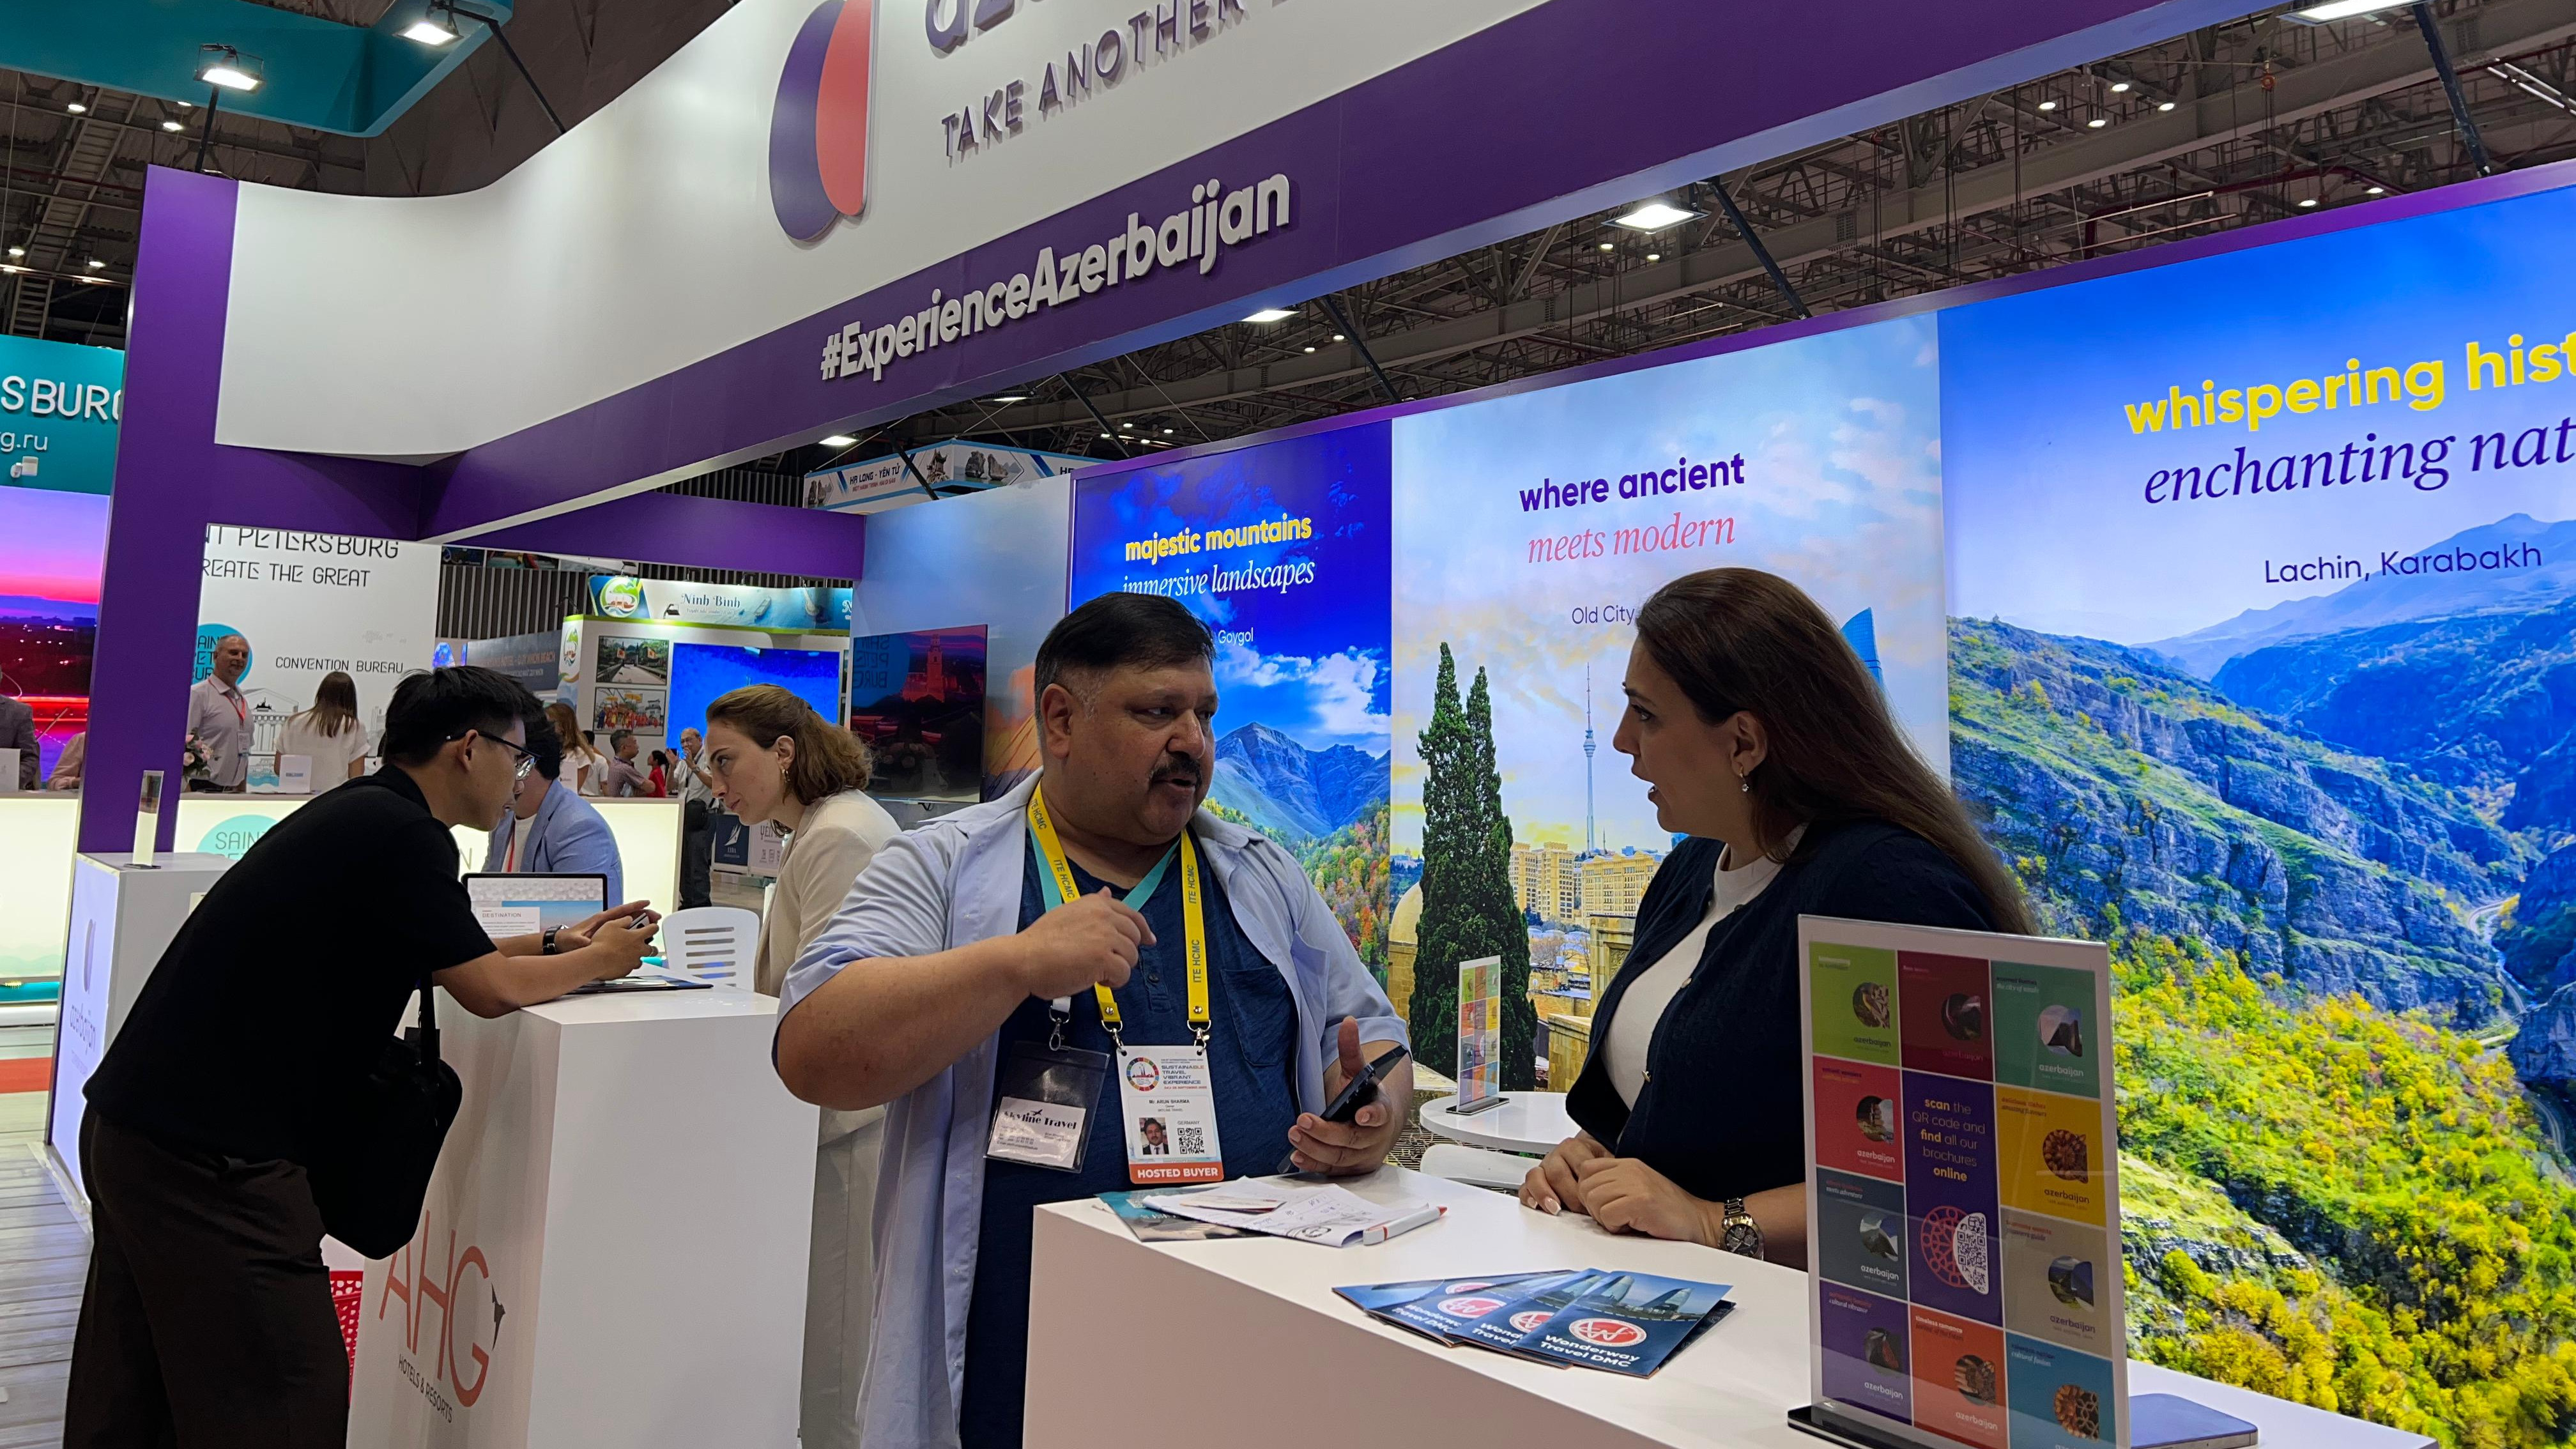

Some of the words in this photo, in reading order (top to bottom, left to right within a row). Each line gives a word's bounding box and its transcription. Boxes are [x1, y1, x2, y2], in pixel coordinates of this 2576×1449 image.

[942, 79, 1024, 158] TAKE
[820, 172, 1290, 381] #ExperienceAzerbaijan
[2124, 357, 2444, 434] whispering
[0, 432, 48, 452] g.ru
[2144, 431, 2456, 504] enchanting
[2470, 415, 2576, 471] nat
[1519, 477, 1609, 512] where
[1618, 452, 1745, 500] ancient
[1125, 528, 1200, 565] majestic
[1206, 512, 1312, 551] mountains
[1528, 528, 1606, 564] meets
[1613, 512, 1735, 555] modern
[2265, 555, 2371, 581] Lachin,
[2381, 541, 2542, 576] Karabakh
[269, 564, 303, 583] THE
[313, 567, 371, 587] GREAT
[1123, 568, 1207, 599] immersive
[1212, 560, 1315, 595] landscapes
[1572, 606, 1598, 625] Old
[1603, 605, 1635, 626] City
[1218, 627, 1254, 647] Goygol
[195, 650, 215, 665] ET
[276, 657, 349, 671] CONVENTION
[356, 661, 403, 673] BUREAU
[1033, 808, 1046, 829] HCMC
[215, 831, 268, 850] SAIN
[1054, 859, 1065, 872] ITE
[1060, 873, 1075, 898] HCMC
[1187, 864, 1195, 889] HCMC
[1188, 891, 1197, 904] ITE
[1192, 939, 1201, 966] HCMC
[1193, 969, 1202, 983] ITE
[1854, 1036, 1891, 1048] azerbaijan
[2039, 1064, 2084, 1077] azerbaijan
[1924, 1099, 1950, 1111] scan
[1954, 1102, 1971, 1115] the
[1912, 1110, 1929, 1124] QR
[1932, 1117, 1960, 1129] code
[1963, 1123, 1986, 1135] and
[1920, 1129, 1942, 1142] find
[1944, 1134, 1957, 1146] all
[1960, 1138, 1977, 1149] our
[1857, 1150, 1895, 1163] azerbaijan
[1923, 1146, 1977, 1167] brochures
[1137, 1169, 1181, 1178] HOSTED
[1183, 1168, 1218, 1177] BUYER
[1933, 1167, 1968, 1182] online
[2044, 1189, 2090, 1204] azerbaijan
[1860, 1265, 1899, 1280] azerbaijan
[379, 1209, 489, 1407] AHG
[2050, 1315, 2096, 1333] azerbaijan
[1540, 1341, 1588, 1358] Travel
[1590, 1354, 1631, 1367] DMC
[1545, 1335, 1640, 1361] Wonderway
[399, 1353, 420, 1388] HOTELS
[420, 1377, 424, 1393] &
[425, 1382, 452, 1423] RESORTS
[1864, 1381, 1903, 1400] azerbaijan
[1956, 1411, 1998, 1430] azerbaijan
